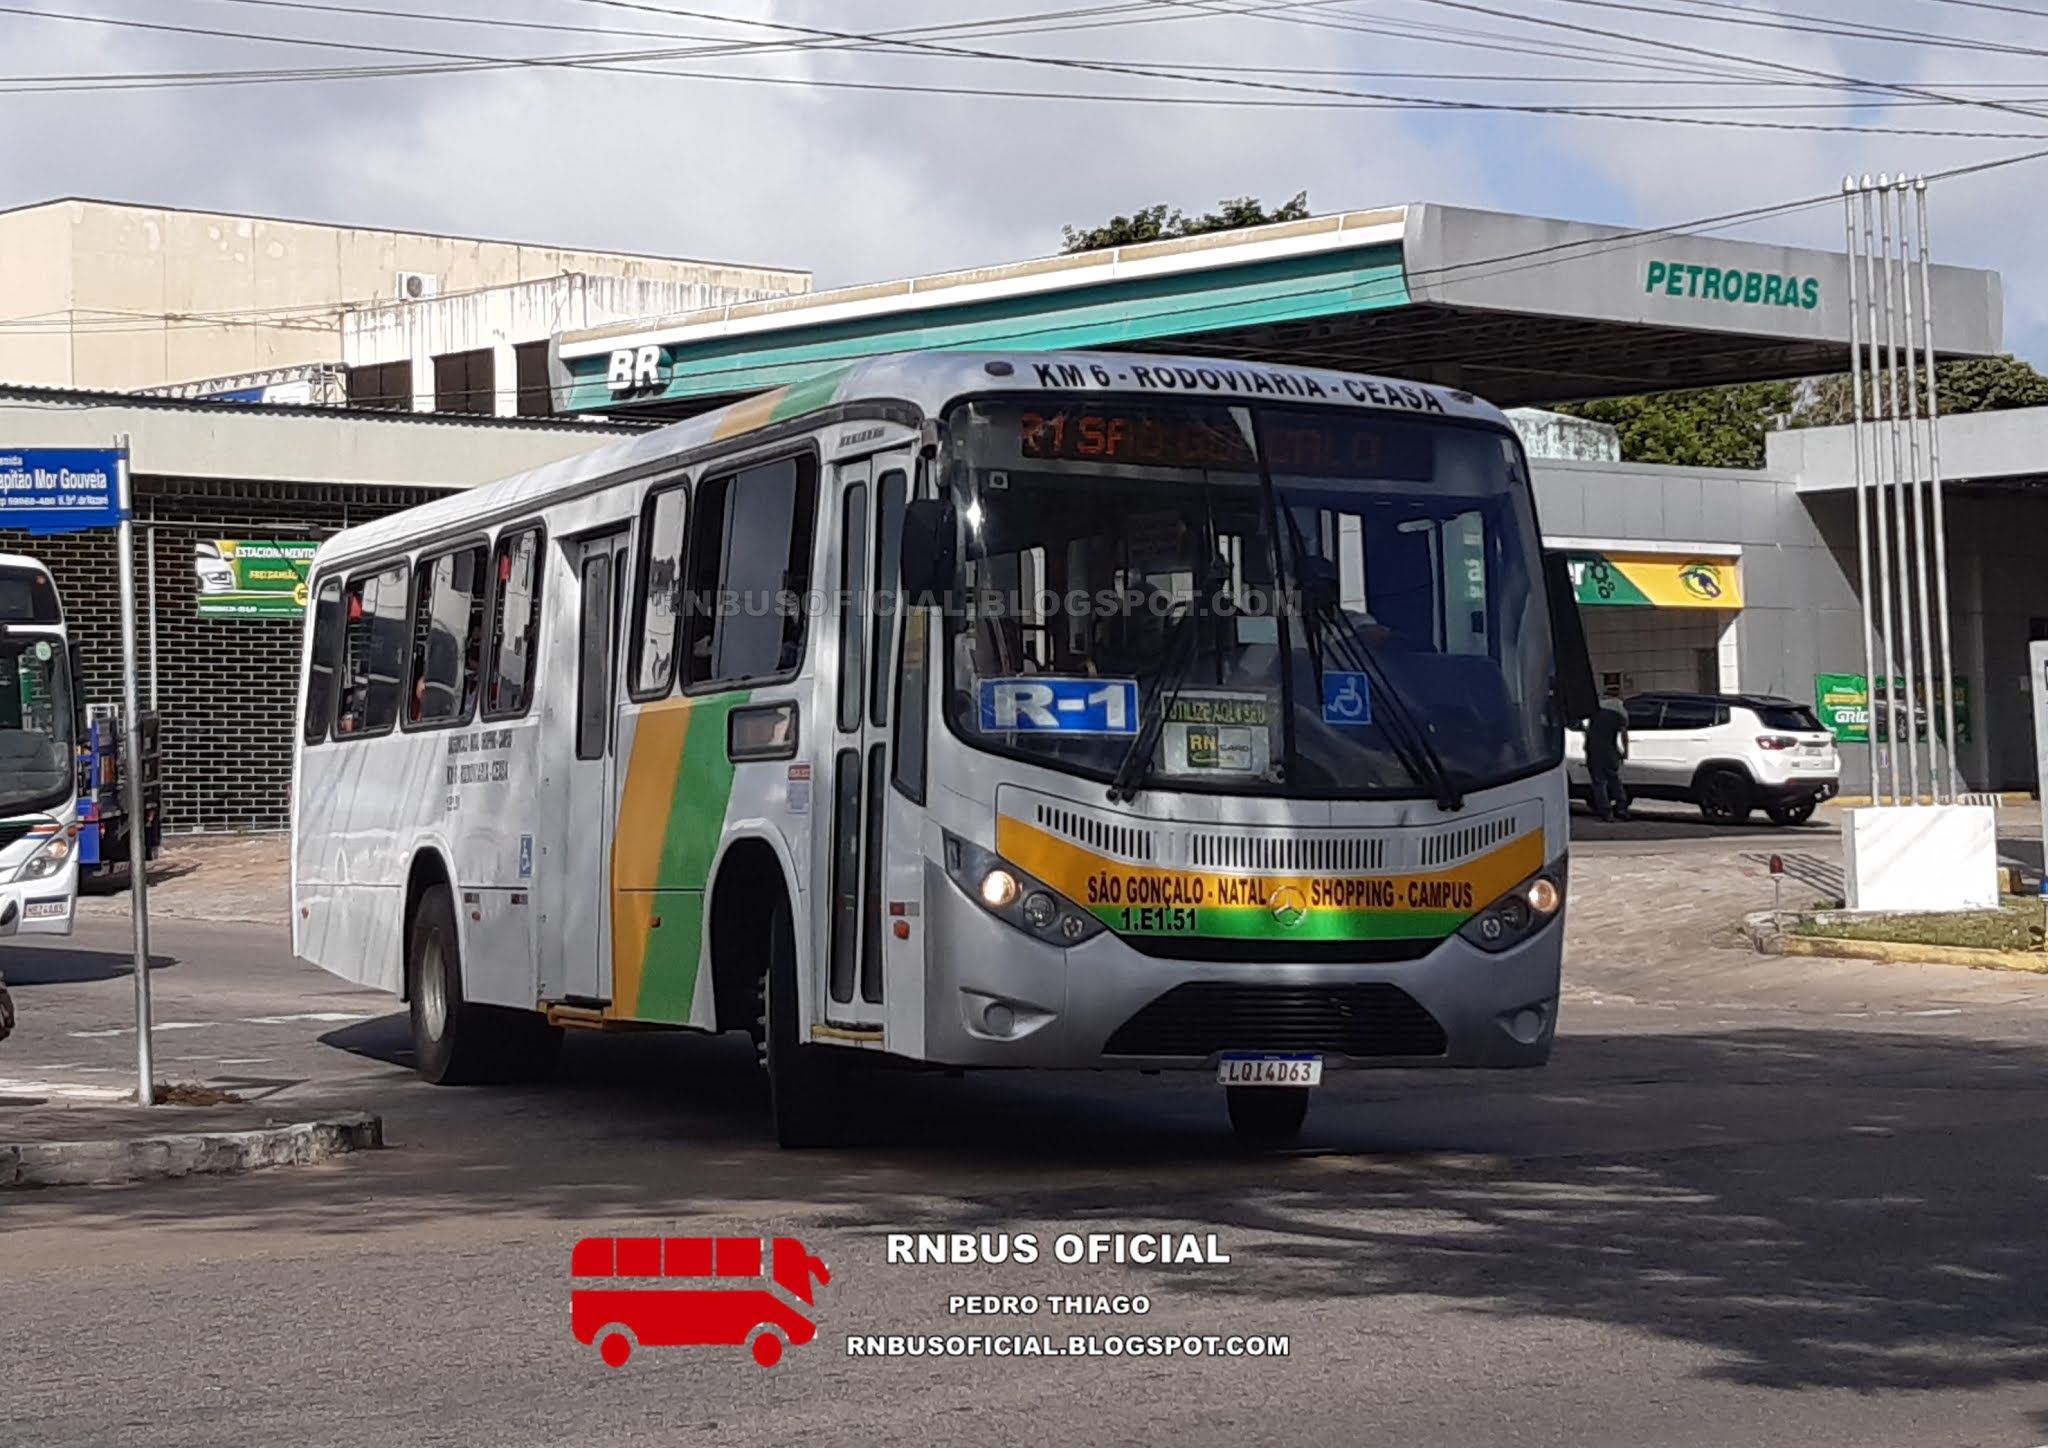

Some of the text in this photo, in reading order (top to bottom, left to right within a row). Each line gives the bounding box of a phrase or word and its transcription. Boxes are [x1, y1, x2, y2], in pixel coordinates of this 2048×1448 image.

[1645, 260, 1819, 310] PETROBRAS
[607, 345, 660, 390] BR
[1032, 363, 1087, 388] KM
[1089, 364, 1111, 387] 6
[1130, 365, 1328, 399] RODOVIARIA
[1342, 379, 1446, 413] CEASA
[0, 467, 107, 495] apitão Mor Gouveia
[235, 546, 316, 559] ESTACIONAMENTO
[994, 683, 1126, 729] R-1
[1087, 871, 1122, 904] SÃO
[1126, 876, 1204, 911] GONÇALO
[1217, 878, 1268, 905] NATAL
[1311, 879, 1395, 908] SHOPPING
[1407, 881, 1473, 909] CAMPUS
[1120, 908, 1197, 931] 1.E1.51
[1229, 1062, 1312, 1082] LQI4D63
